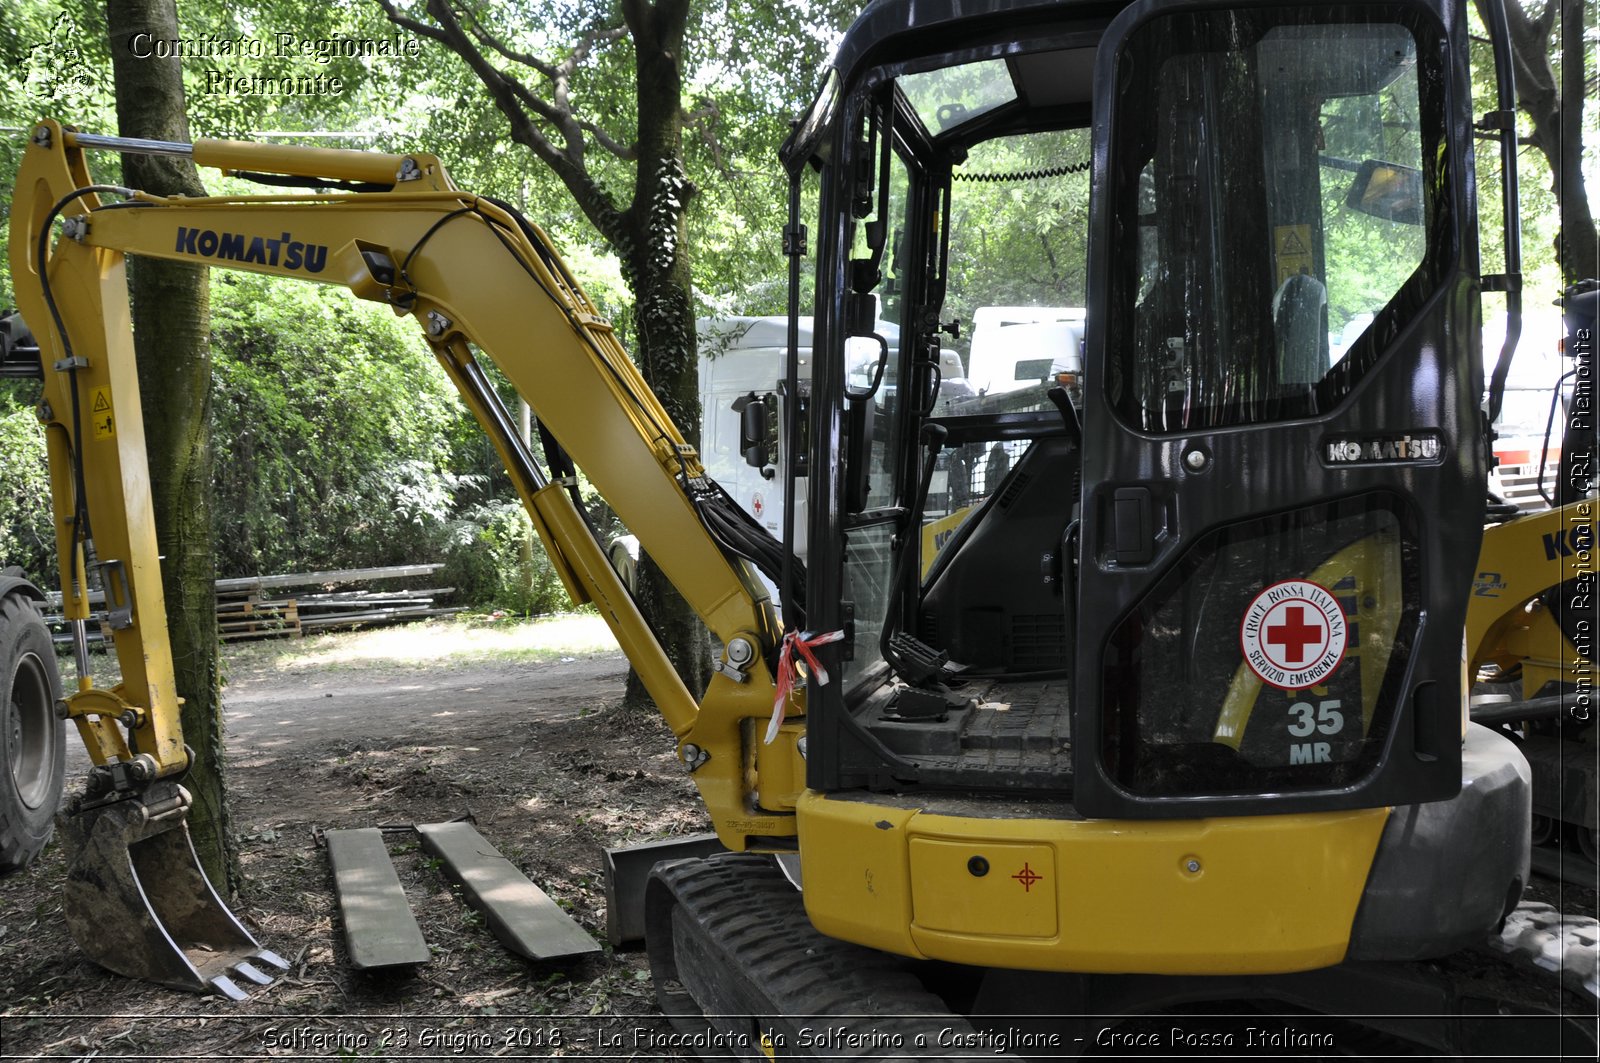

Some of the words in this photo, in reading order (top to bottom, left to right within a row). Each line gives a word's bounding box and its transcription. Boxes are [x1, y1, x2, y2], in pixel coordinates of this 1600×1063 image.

[176, 227, 328, 273] KOMATSU
[1326, 435, 1439, 461] KOMATSU
[1245, 601, 1268, 639] CROCE
[1267, 584, 1305, 604] ROSSA
[1310, 588, 1343, 638] ITALIANA
[1249, 650, 1285, 683] SERVIZIO
[1289, 651, 1338, 685] EMERGENZE
[1287, 699, 1344, 737] 35
[1289, 742, 1332, 765] MR
